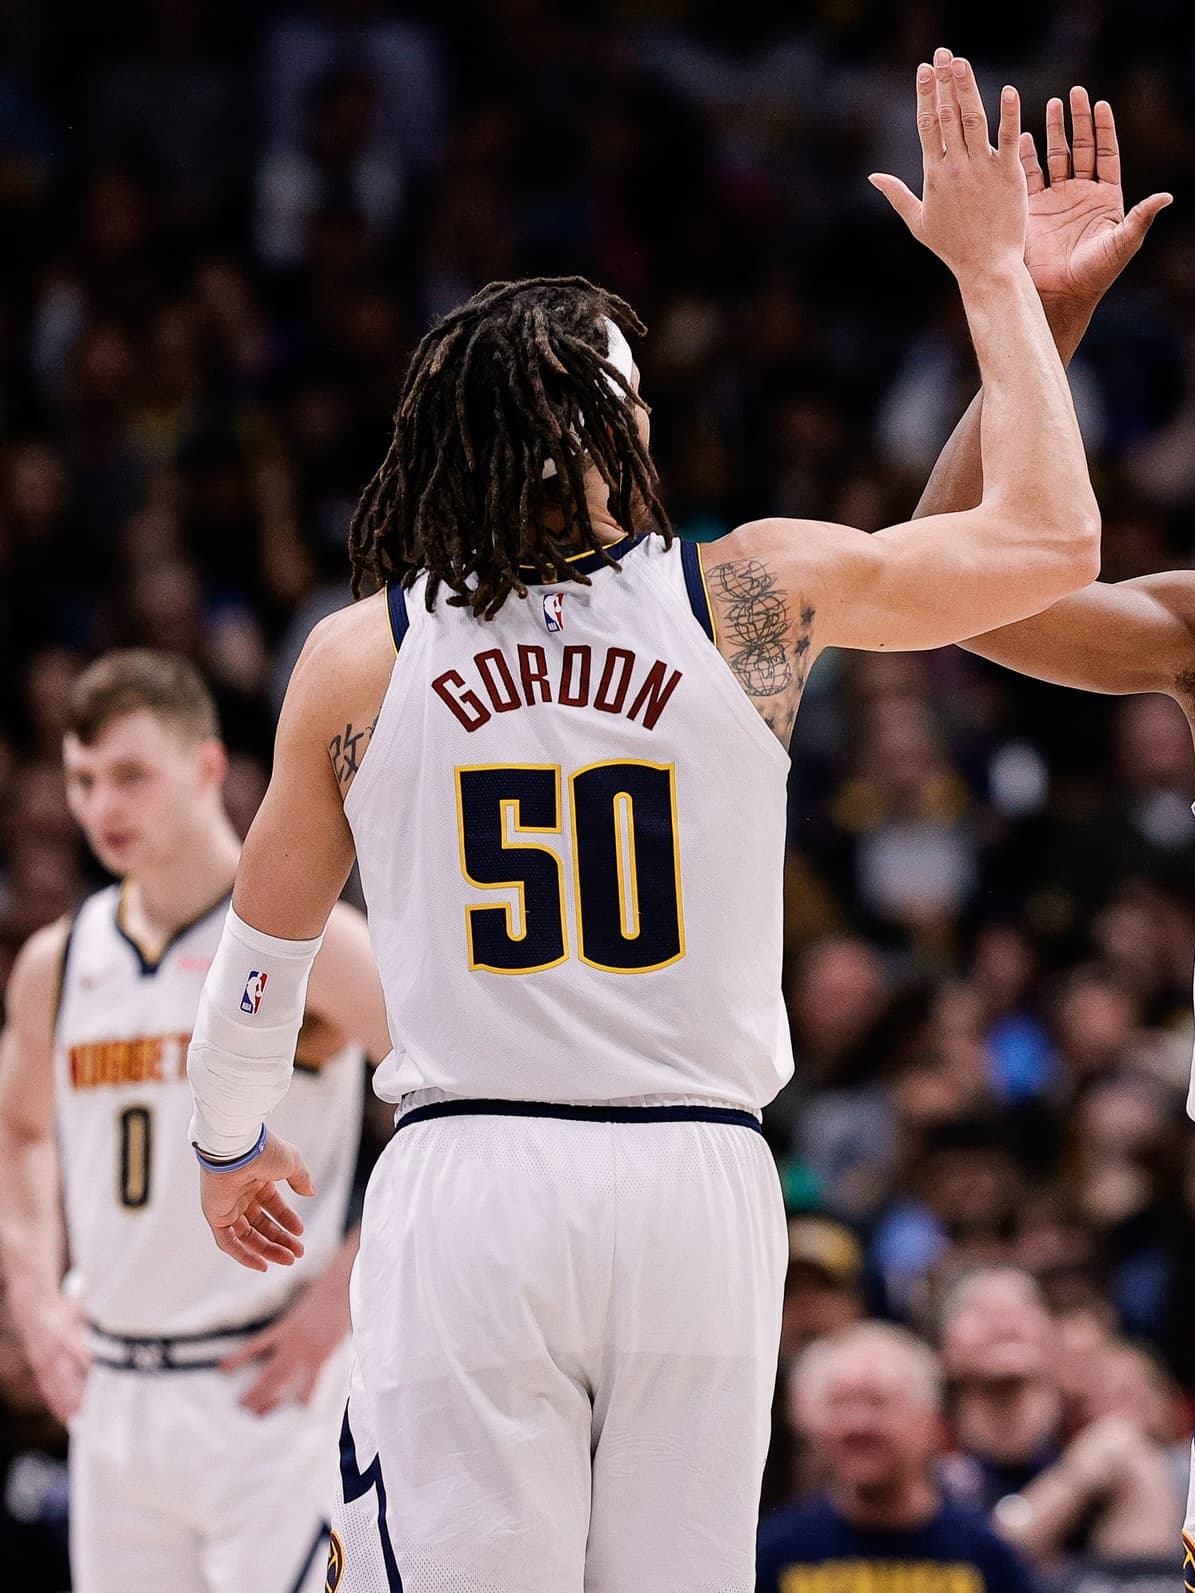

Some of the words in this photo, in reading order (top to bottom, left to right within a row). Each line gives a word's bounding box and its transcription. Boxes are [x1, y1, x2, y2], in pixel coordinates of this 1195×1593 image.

[431, 644, 682, 732] GORDON
[455, 758, 686, 975] 50
[118, 1106, 152, 1208] 0
